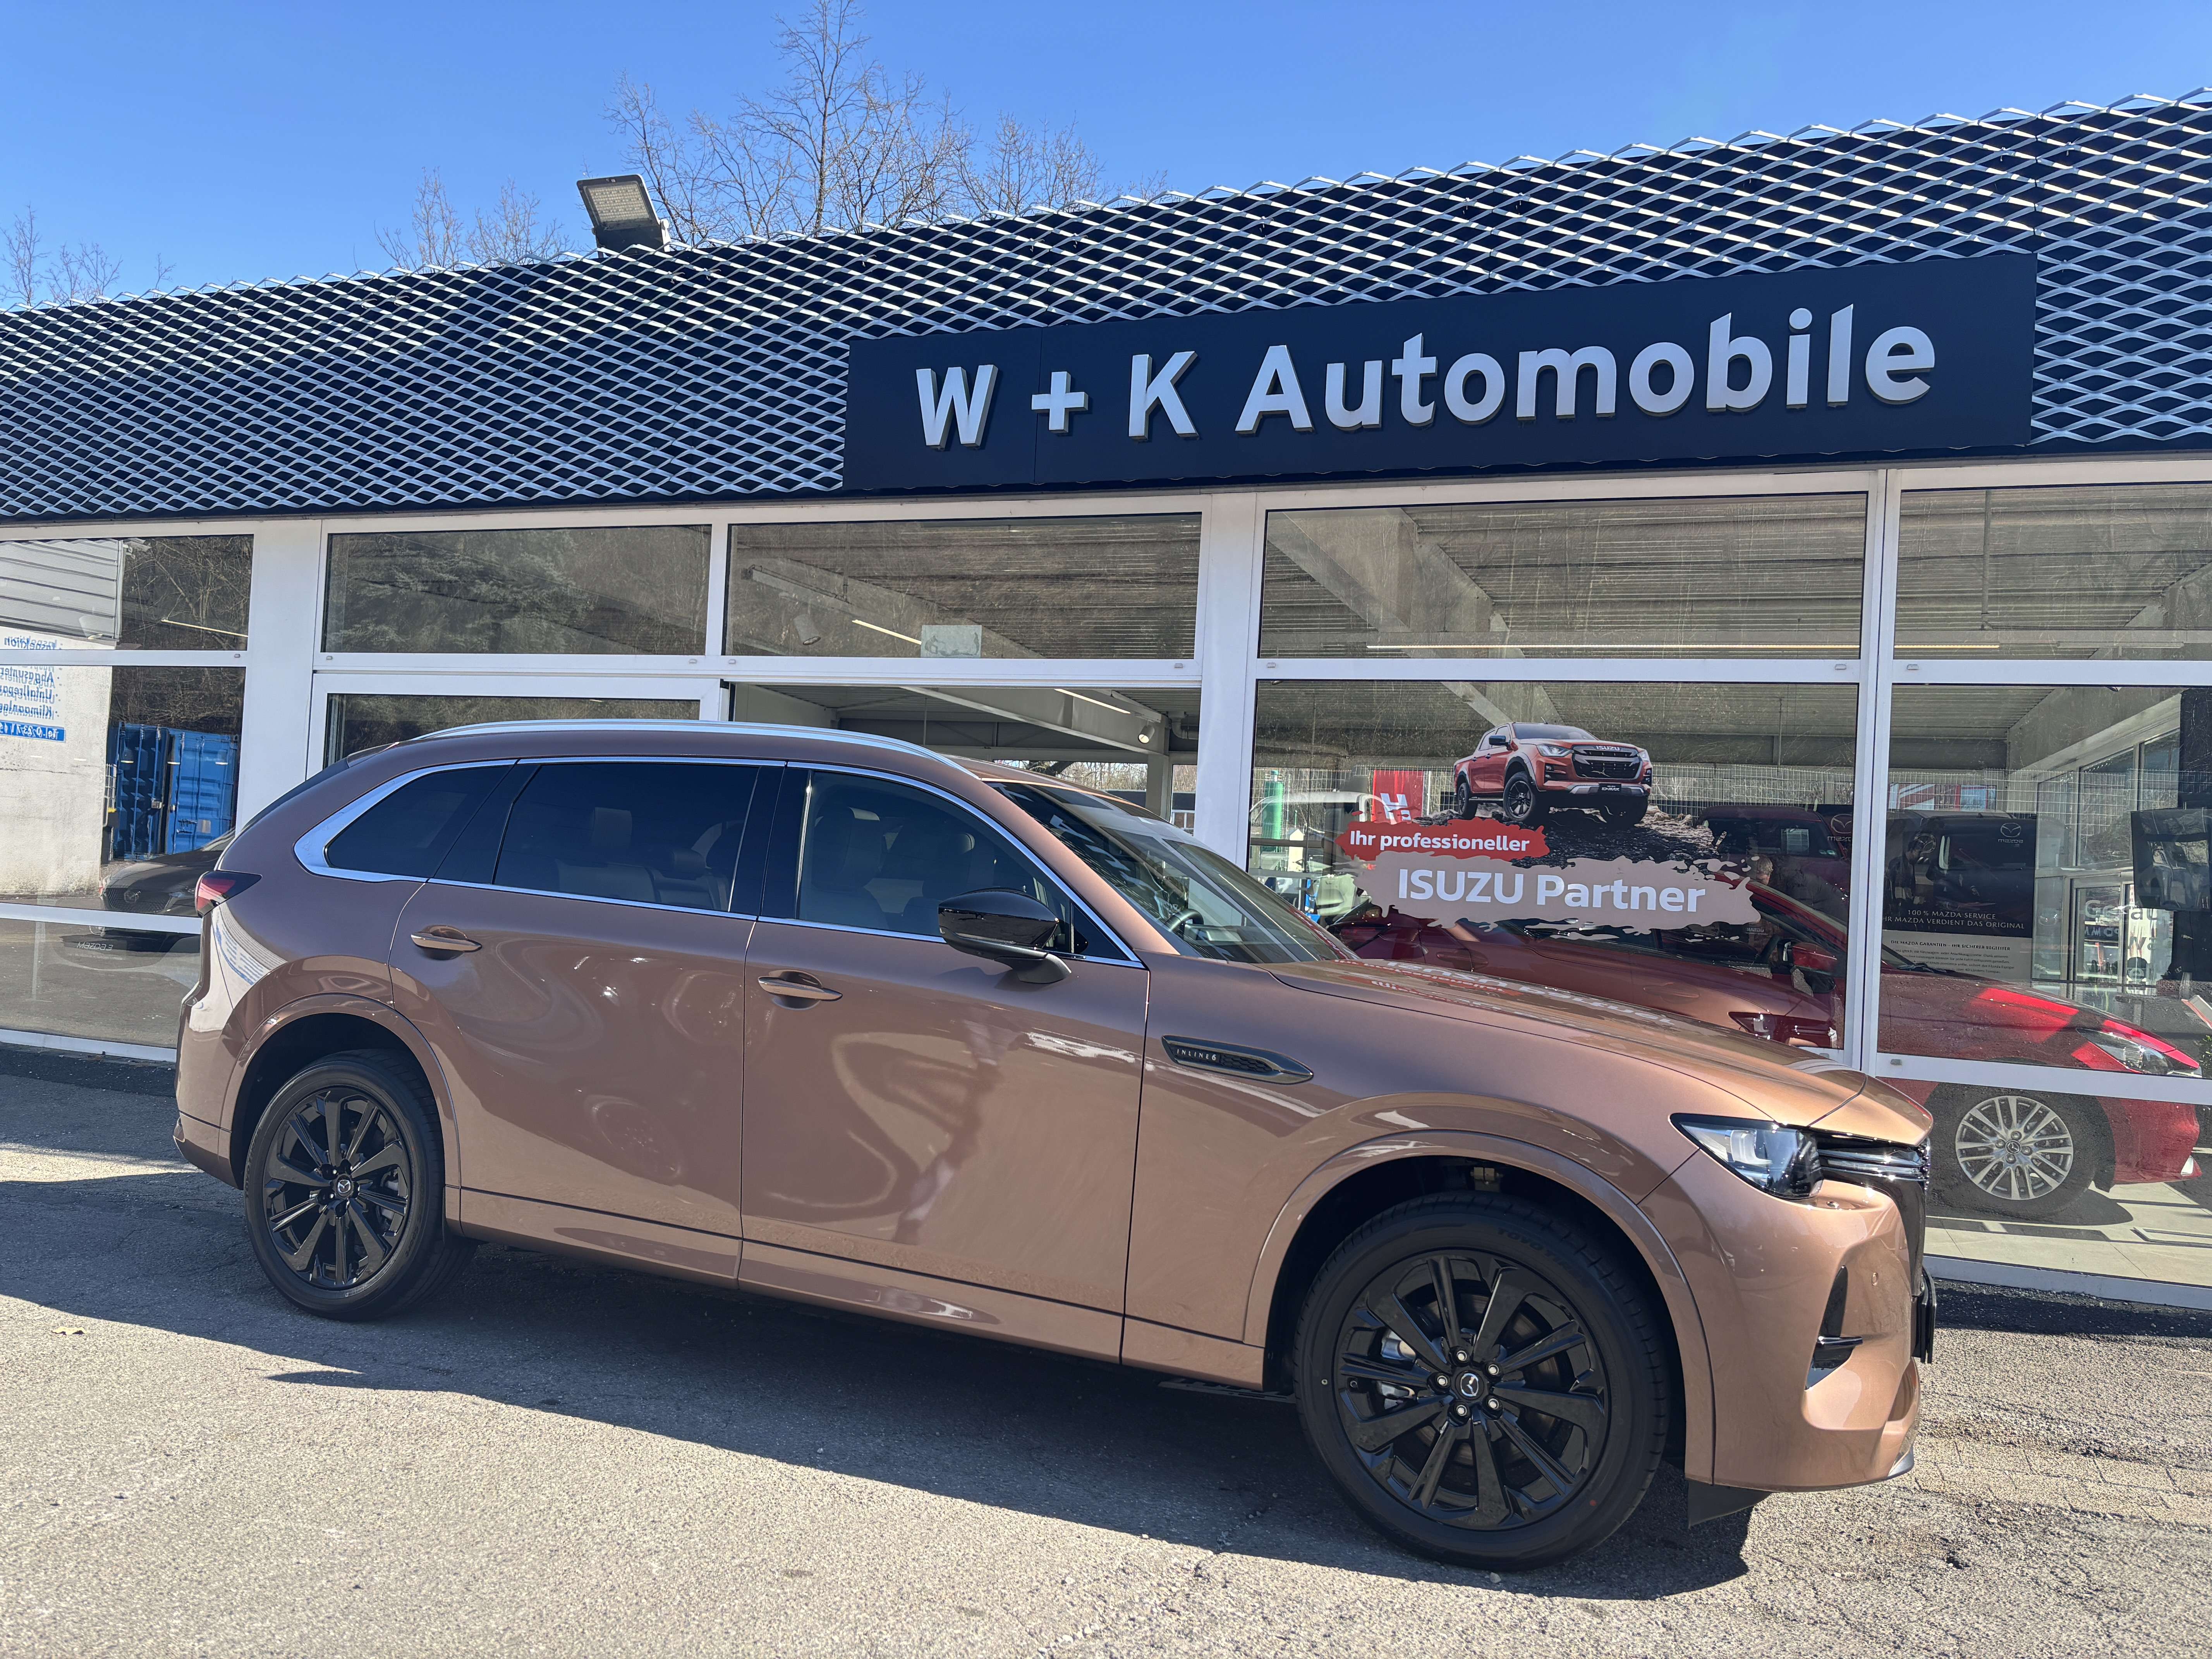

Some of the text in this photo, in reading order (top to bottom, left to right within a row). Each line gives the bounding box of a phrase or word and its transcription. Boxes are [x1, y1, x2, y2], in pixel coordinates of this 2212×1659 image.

[915, 303, 1936, 449] W + K Automobile
[1350, 831, 1530, 851] Ihr professioneller
[1398, 868, 1706, 912] ISUZU Partner
